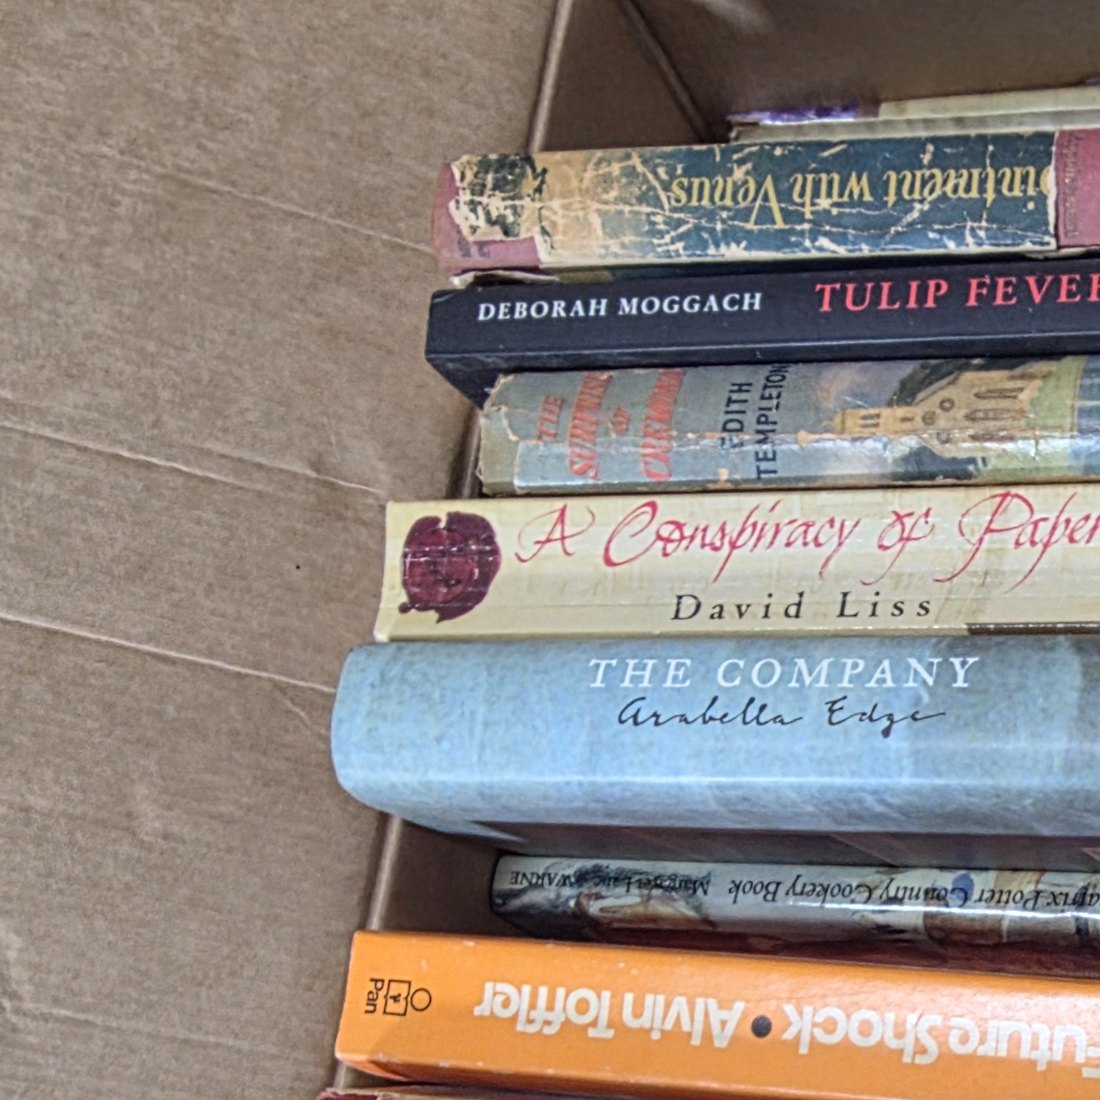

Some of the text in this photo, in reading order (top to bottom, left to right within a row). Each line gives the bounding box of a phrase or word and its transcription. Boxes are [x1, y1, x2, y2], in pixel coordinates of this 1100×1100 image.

[671, 173, 786, 228] Venus
[790, 168, 874, 219] with
[477, 297, 609, 322] DEBORAH
[617, 291, 764, 317] MOGGACH
[815, 277, 950, 314] TULIP
[718, 379, 754, 450] EDITH
[754, 361, 792, 481] TEMPLETON
[514, 503, 596, 564] A
[602, 498, 860, 583] Conspiracy
[860, 505, 936, 587] of
[671, 589, 933, 622] David Liss
[589, 655, 980, 690] THE COMPANY
[616, 694, 948, 738] Arabella Edge
[510, 869, 576, 889] WARNE
[728, 878, 782, 905] Book
[786, 874, 873, 909] Cookery
[880, 878, 969, 909] Country
[975, 884, 1041, 908] Potter
[364, 976, 385, 1015] Pan
[473, 979, 615, 1041] Toffler
[621, 990, 746, 1049] Alvin
[782, 1003, 941, 1066] Shock
